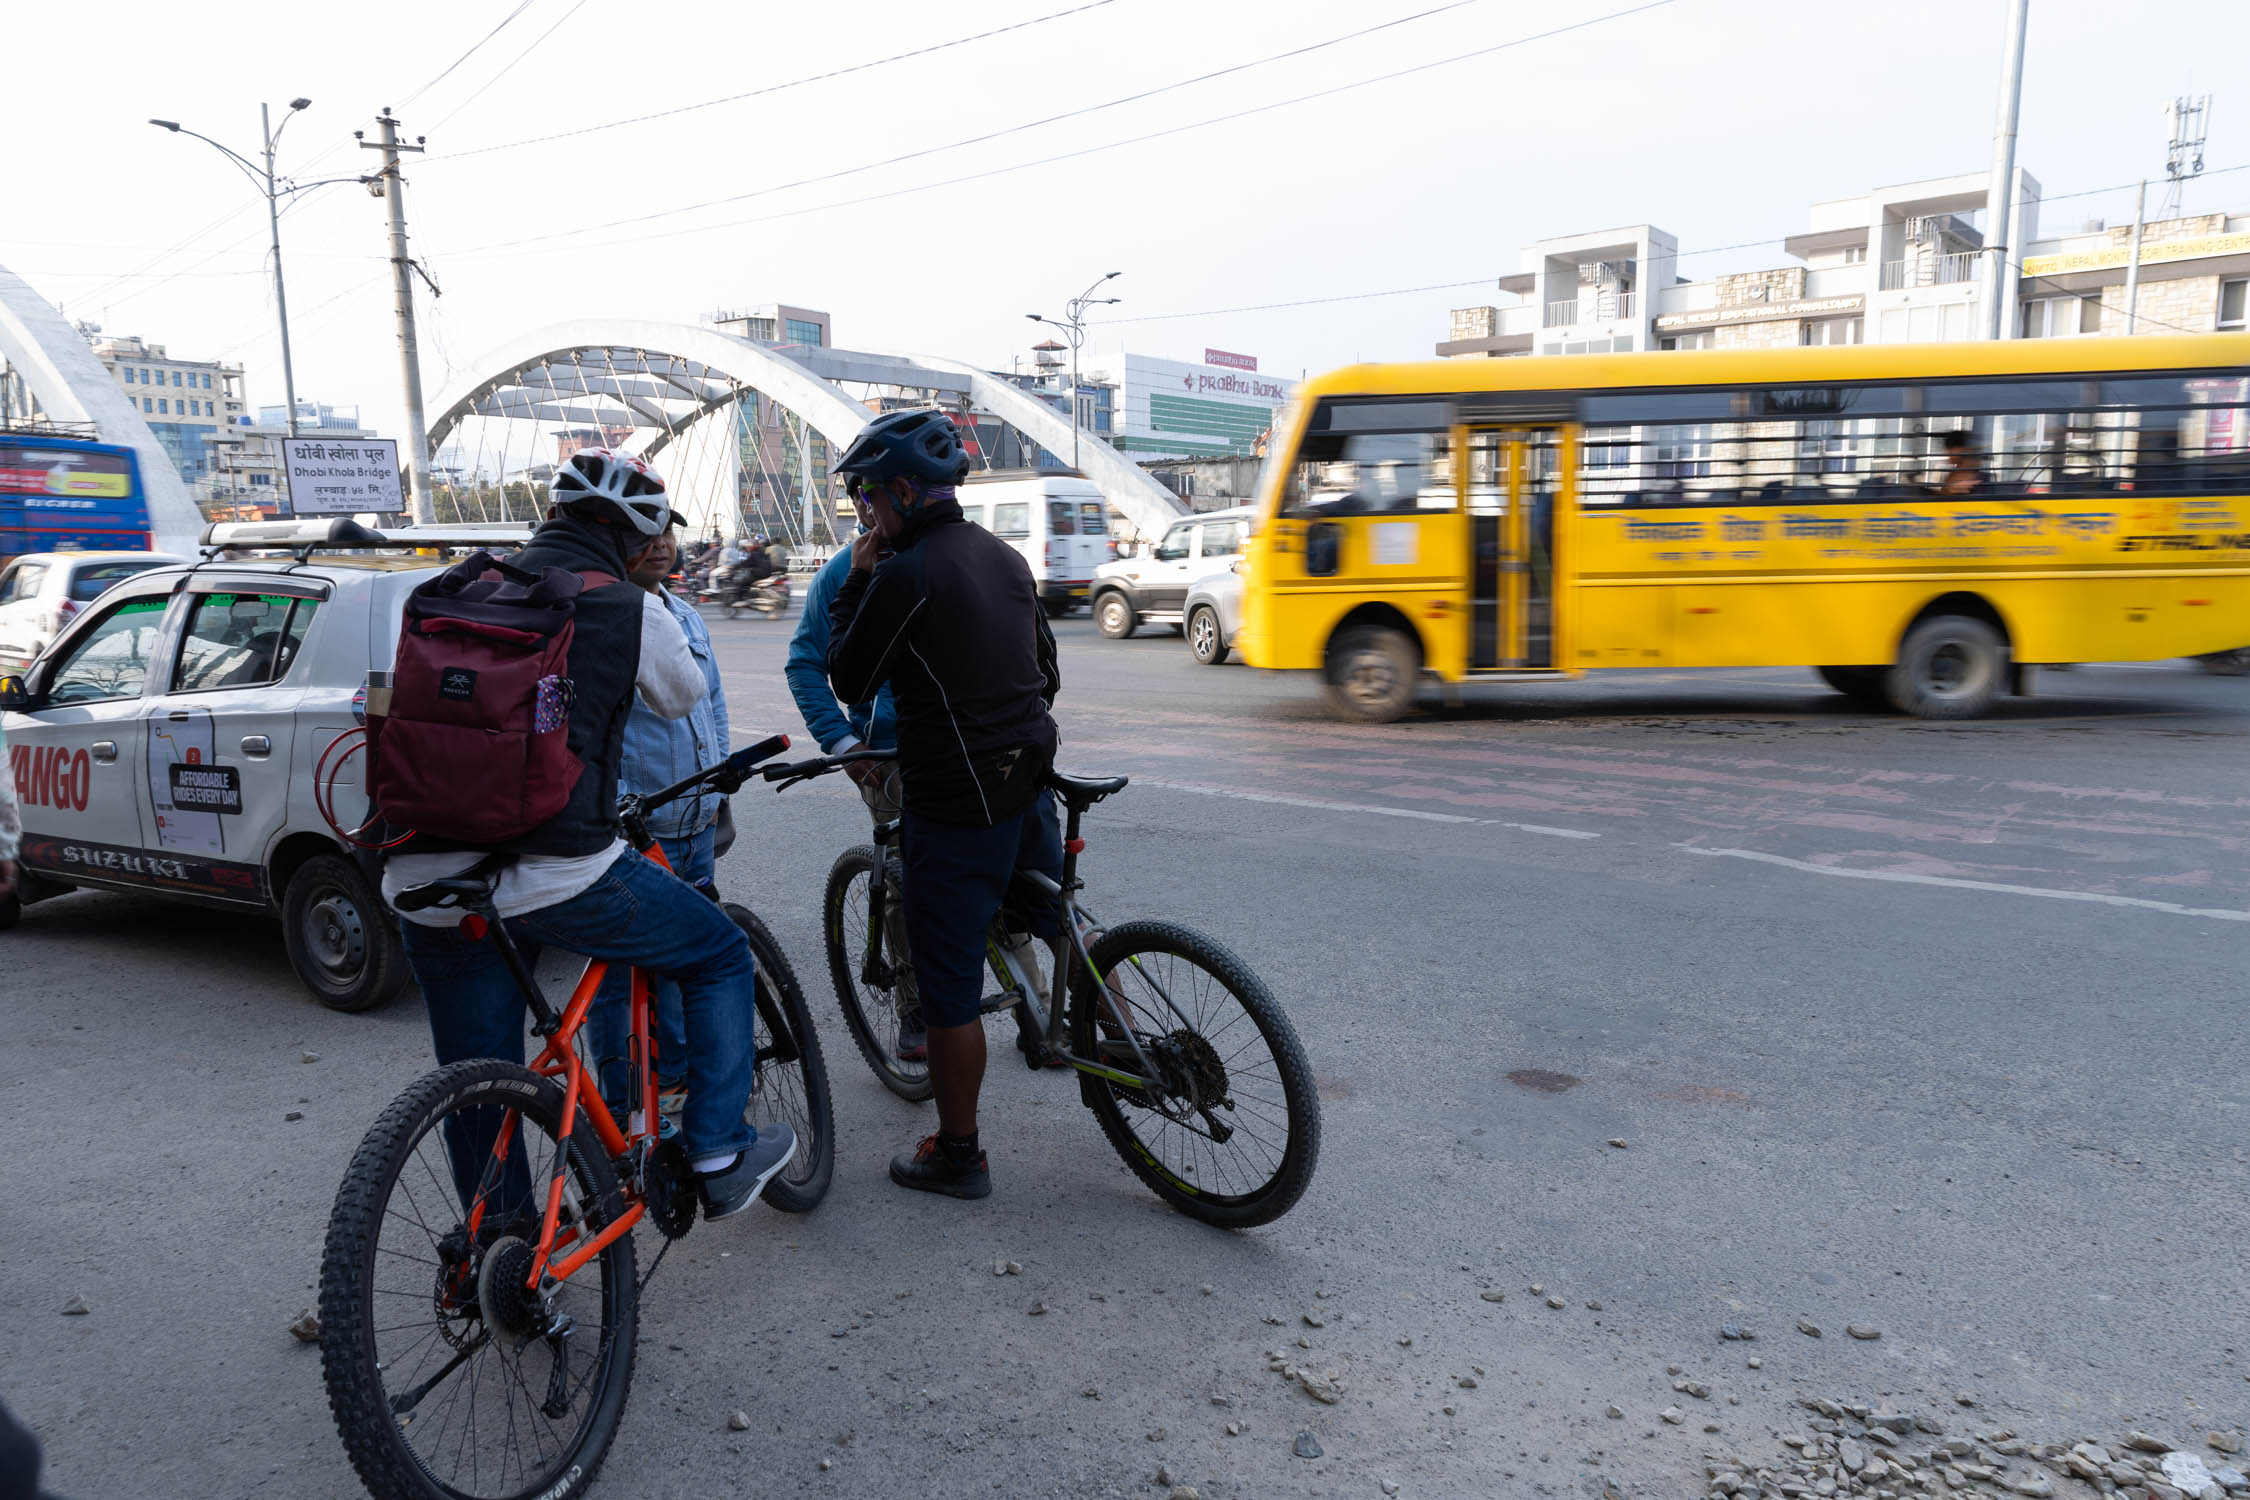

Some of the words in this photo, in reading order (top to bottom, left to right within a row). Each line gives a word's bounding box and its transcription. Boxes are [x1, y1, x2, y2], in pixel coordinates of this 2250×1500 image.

[2064, 255, 2096, 269] NEPAL
[1657, 315, 1686, 327] NEPAL
[1721, 306, 1788, 320] EDUCATIONAL
[1789, 297, 1863, 313] CONSULTANCY
[328, 443, 359, 462] खोला
[362, 448, 385, 464] पुल
[294, 466, 326, 477] Dhobi
[328, 467, 355, 477] Khola
[357, 467, 392, 480] Bridge
[179, 770, 230, 789] AFFORDABLE
[173, 786, 195, 802] RIDES
[195, 787, 220, 804] EVERY
[221, 789, 238, 806] DAY
[63, 845, 190, 880] SUZUKI
